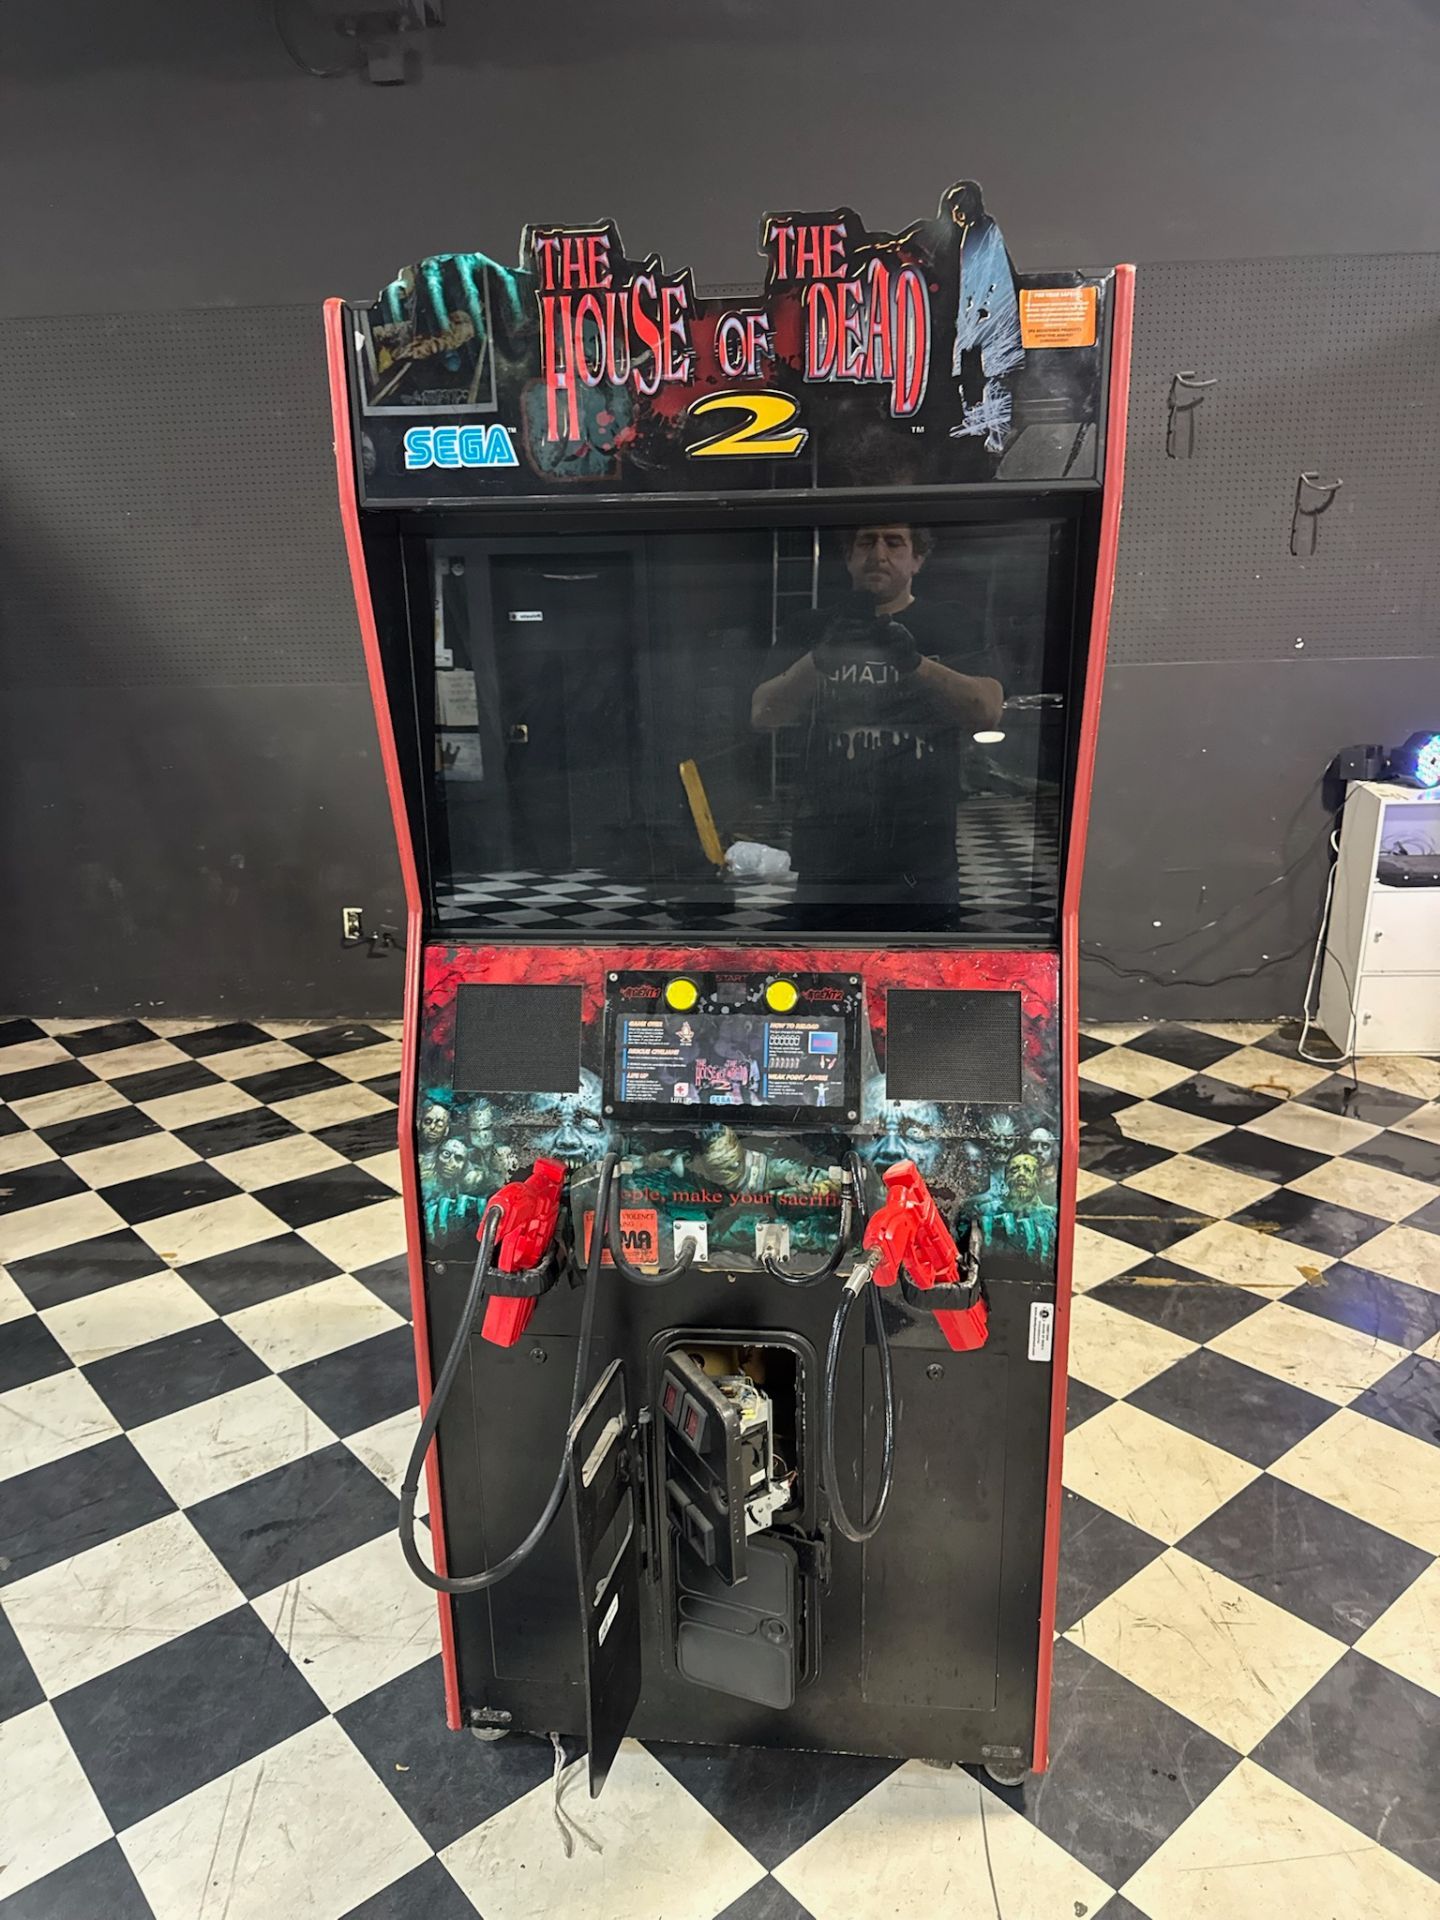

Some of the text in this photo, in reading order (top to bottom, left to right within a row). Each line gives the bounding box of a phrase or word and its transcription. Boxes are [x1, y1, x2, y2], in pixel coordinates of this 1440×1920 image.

[535, 235, 611, 290] THE
[769, 223, 848, 280] THE
[541, 257, 927, 442] HOUSE OF DEAD
[404, 424, 519, 469] SEGA
[689, 393, 807, 458] 2
[673, 1189, 722, 1203] make
[729, 1190, 773, 1207] your
